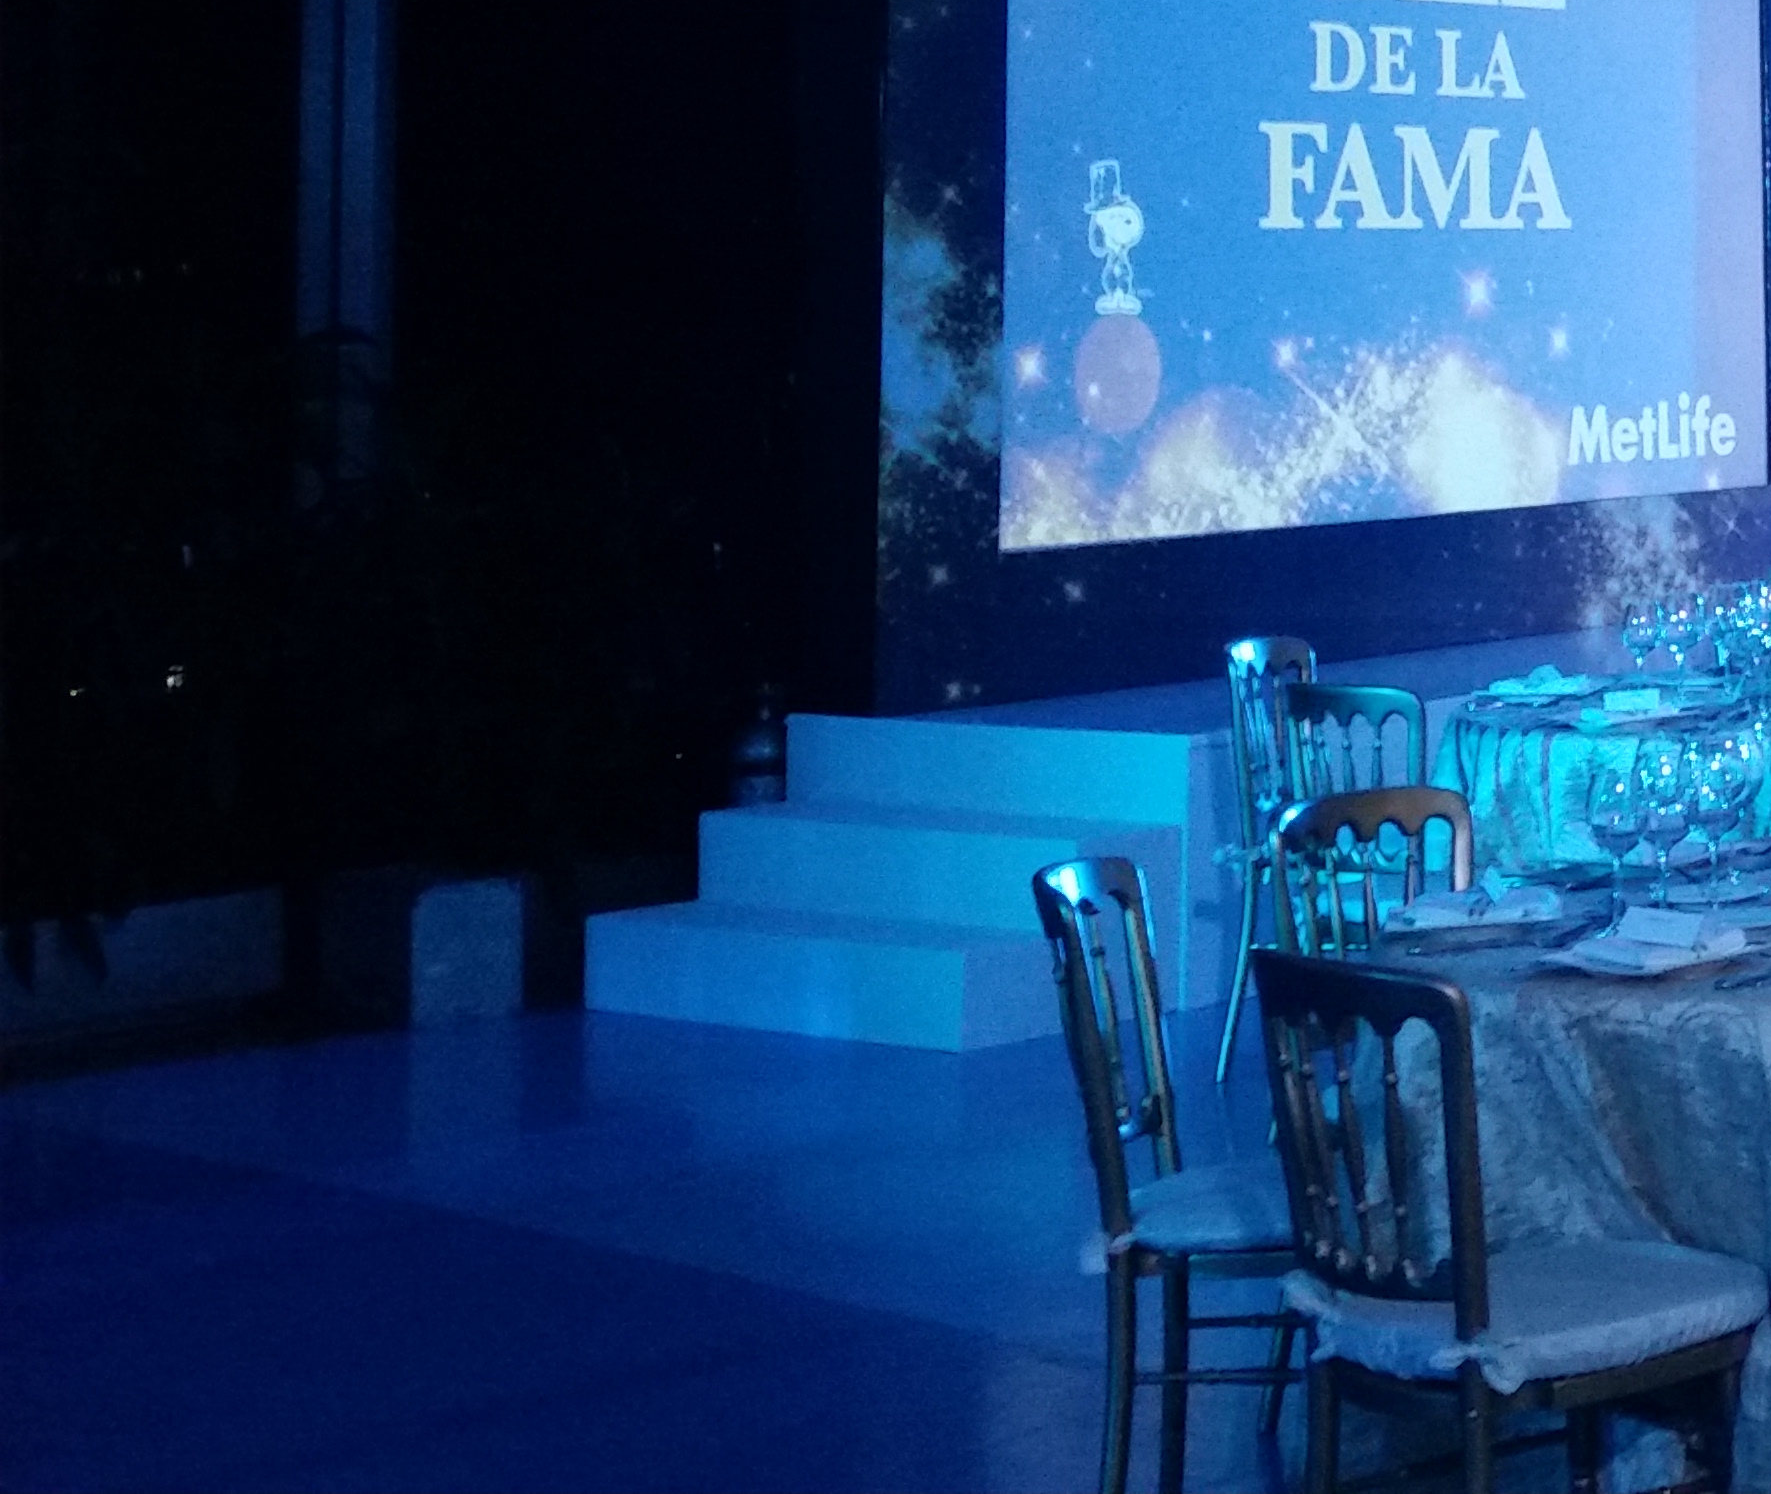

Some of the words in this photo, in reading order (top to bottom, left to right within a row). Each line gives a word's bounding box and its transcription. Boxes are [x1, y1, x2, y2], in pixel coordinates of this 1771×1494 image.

[1309, 21, 1416, 96] DE
[1435, 28, 1526, 100] LA
[1257, 120, 1573, 230] FAMA
[1567, 392, 1737, 466] MetLife
